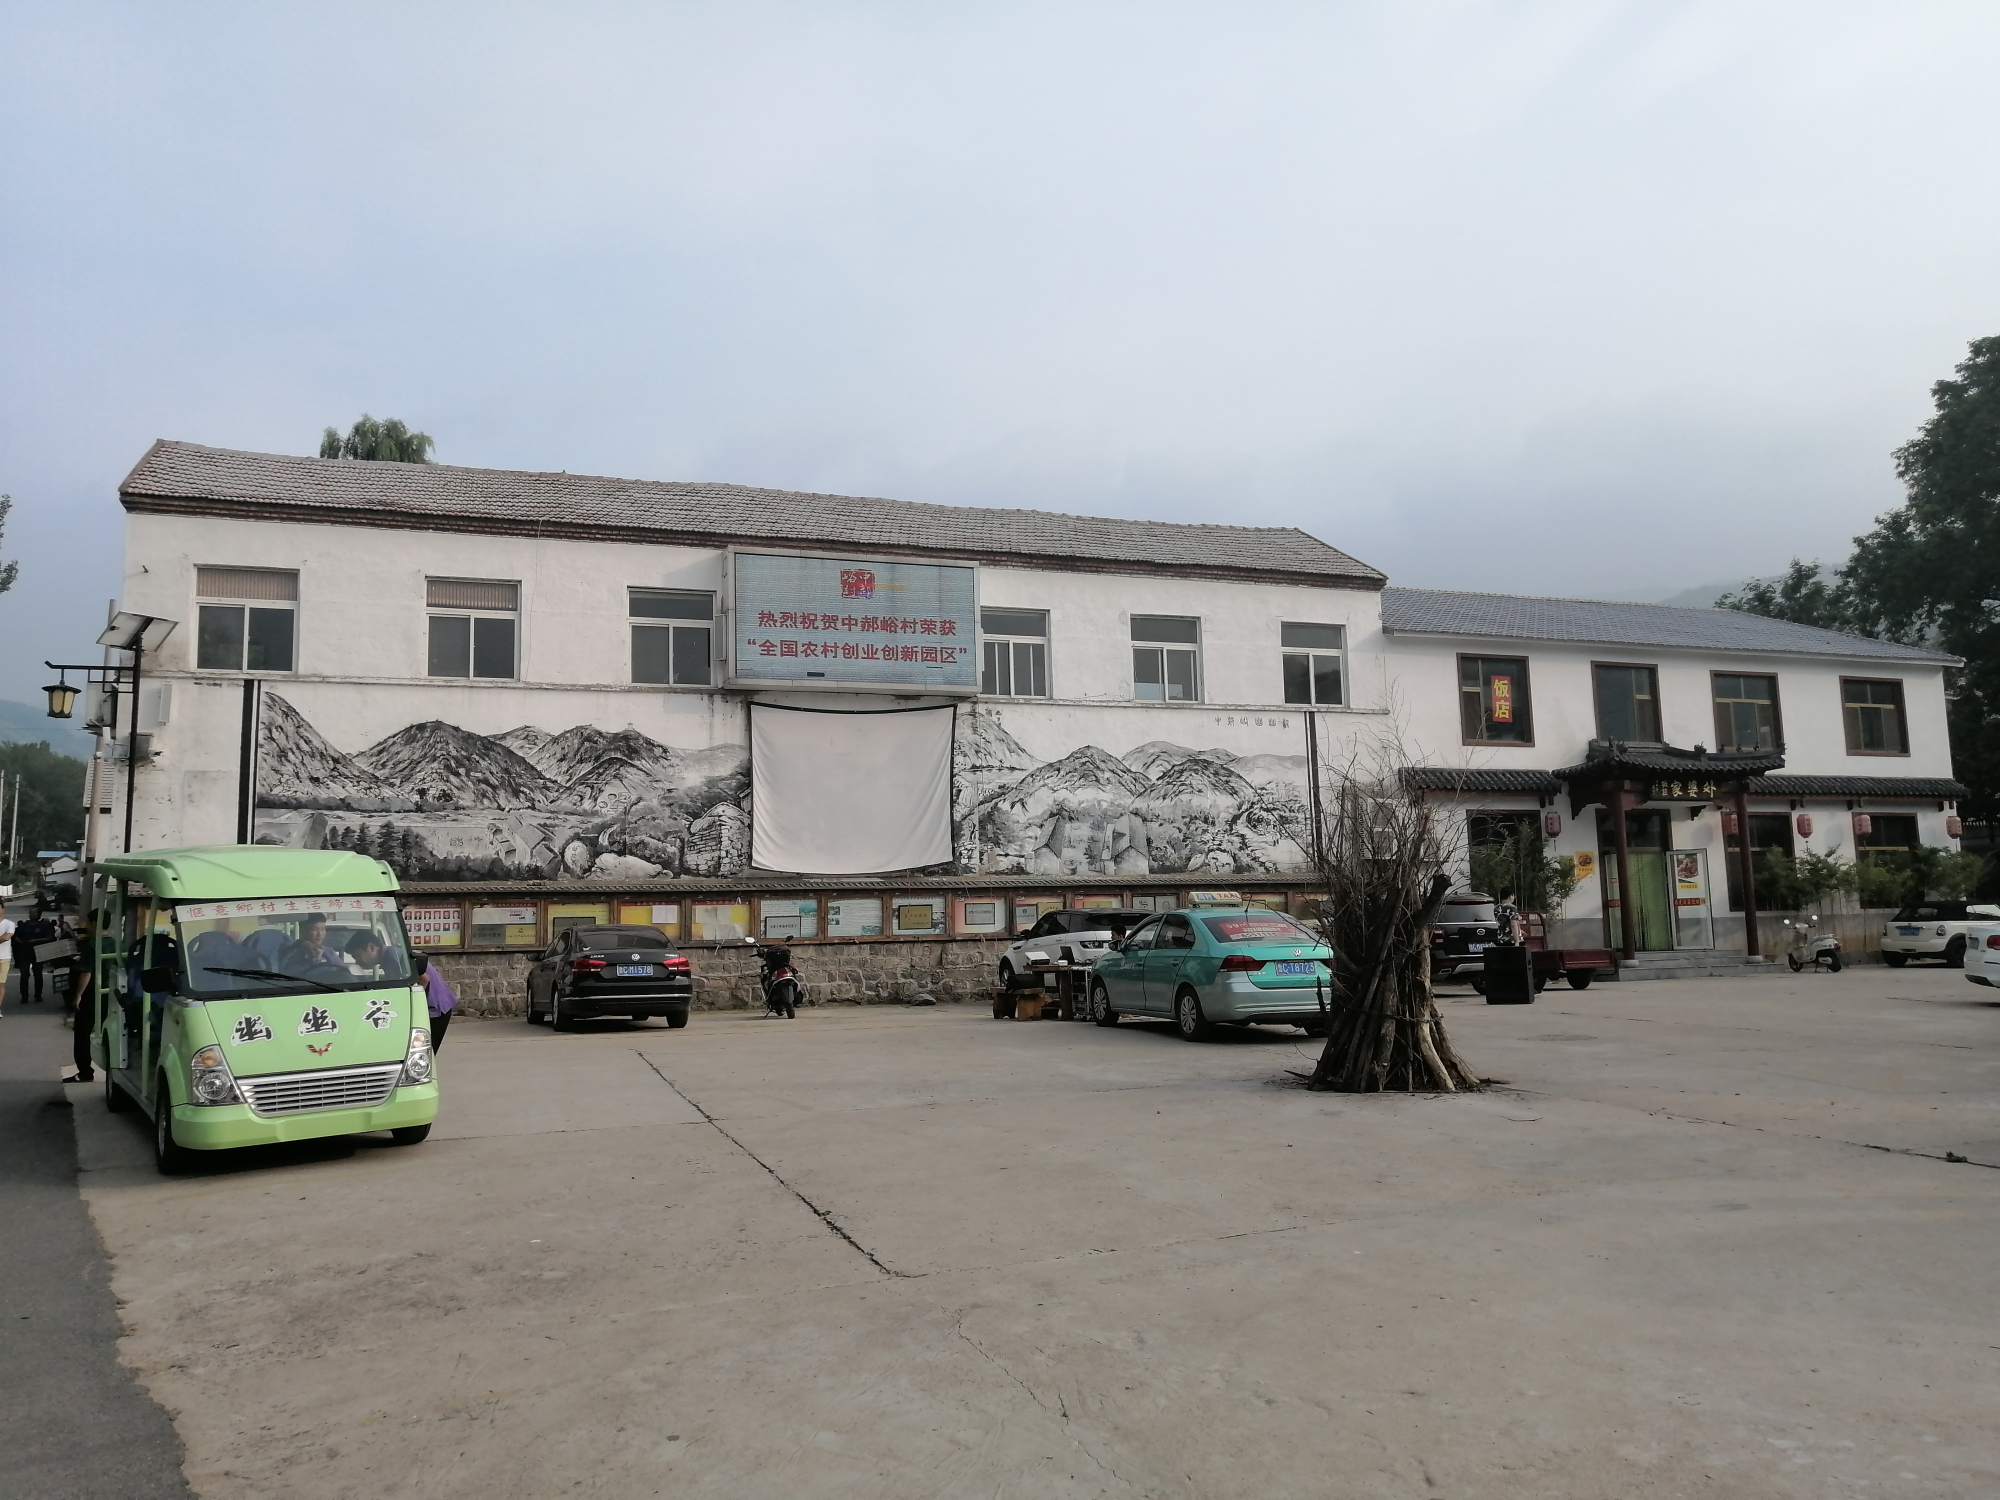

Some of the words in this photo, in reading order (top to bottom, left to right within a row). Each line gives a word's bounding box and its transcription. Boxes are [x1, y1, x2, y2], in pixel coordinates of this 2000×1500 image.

[758, 610, 957, 636] 热烈祝贺中郝峪村荣获
[747, 638, 967, 663] “全国农村创业创新园区”
[1494, 678, 1511, 720] 饭店
